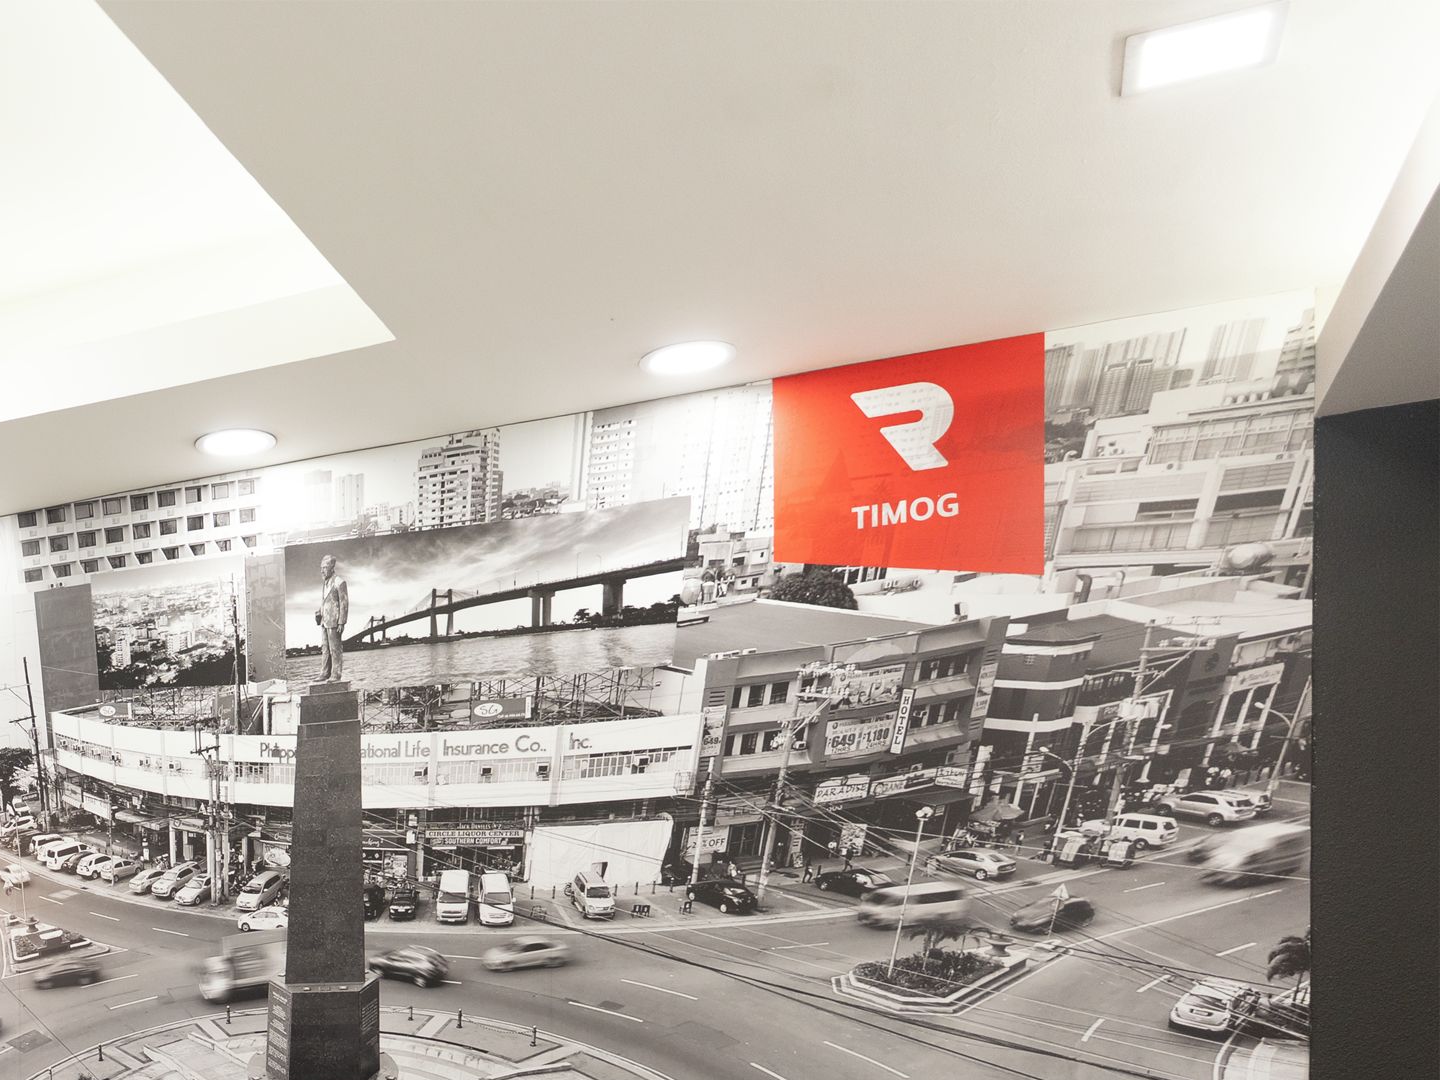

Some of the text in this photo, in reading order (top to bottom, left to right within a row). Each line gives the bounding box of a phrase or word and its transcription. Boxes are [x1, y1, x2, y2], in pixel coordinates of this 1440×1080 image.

[851, 492, 959, 530] TIMOG
[894, 696, 911, 745] HOTEL
[361, 741, 401, 759] ational
[405, 739, 431, 758] Life
[442, 738, 510, 757] Insurance
[568, 731, 593, 750] Inc.
[428, 830, 456, 838] CIRCLE
[444, 836, 502, 845] SOUTHERN COMFORT
[708, 837, 726, 847] OFF
